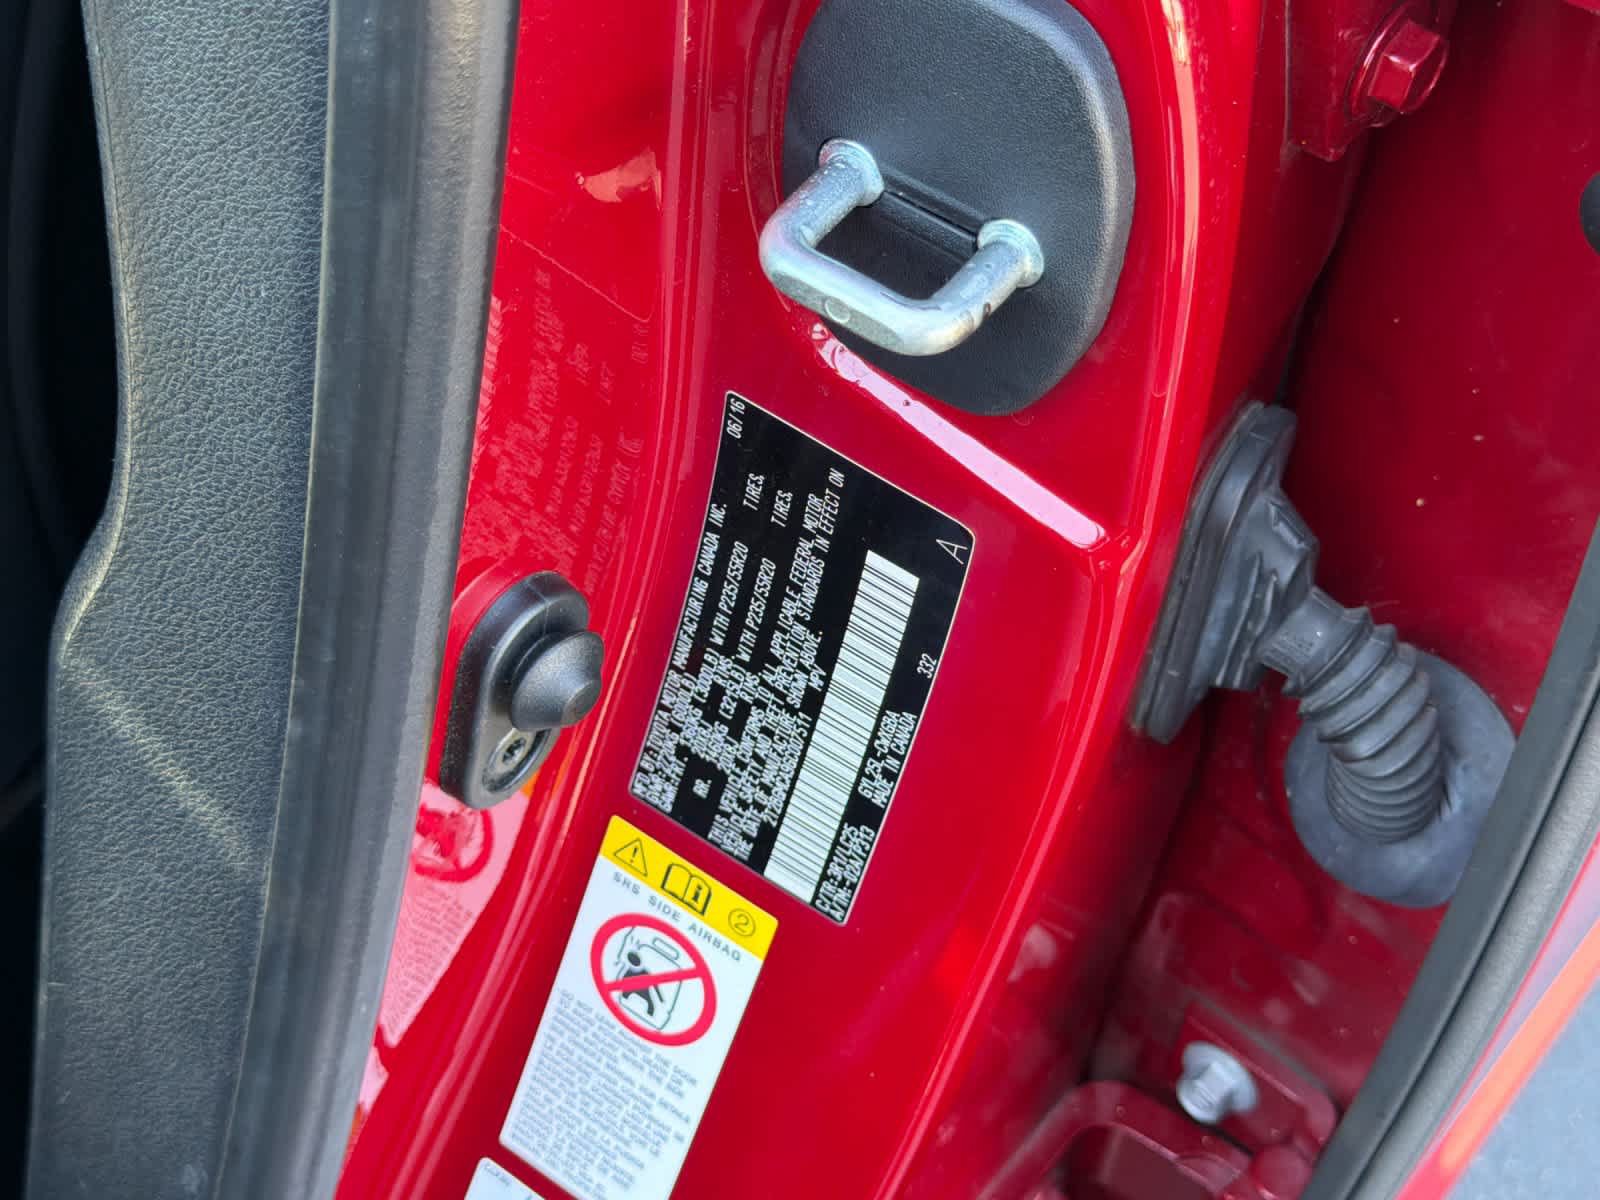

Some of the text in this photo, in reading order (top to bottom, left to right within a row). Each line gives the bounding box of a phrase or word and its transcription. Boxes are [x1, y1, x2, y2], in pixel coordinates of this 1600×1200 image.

[726, 397, 745, 438] 06/16
[708, 503, 726, 527] INC.
[697, 531, 720, 575] CANADA
[935, 537, 967, 564] A
[718, 540, 748, 614] P235/55R20
[744, 557, 776, 631] P235/55R20
[671, 576, 708, 669] MANUFACTURING
[709, 612, 729, 645] WITH
[720, 467, 844, 854] VEHICLE SAFETY AND THEFT PREVENTION STANDARDS IN EFFECT ON
[735, 628, 756, 662] WITH
[916, 653, 936, 678] 332
[660, 669, 682, 711] MOTOR
[691, 647, 720, 703] (3000LB)
[707, 493, 824, 846] THIS VEHICLE CONFORMS TO ALL APPLICABLE FEDERAL MOTOR
[712, 655, 735, 687] RIMS.
[739, 671, 762, 704] RIMS.
[807, 663, 826, 691] MPV
[669, 672, 697, 728] (6000LB)
[718, 663, 747, 719] (3215LB)
[704, 720, 729, 766] 1460KG
[733, 629, 822, 860] THE DATE OF MANUFACTURE SHOWN ABOVE.
[890, 711, 917, 755] CANADA
[883, 754, 900, 773] IN
[692, 778, 711, 798] RR.
[871, 773, 894, 808] MADE
[613, 871, 741, 961] SRS SIDE AIRBAG
[733, 912, 750, 934] 2
